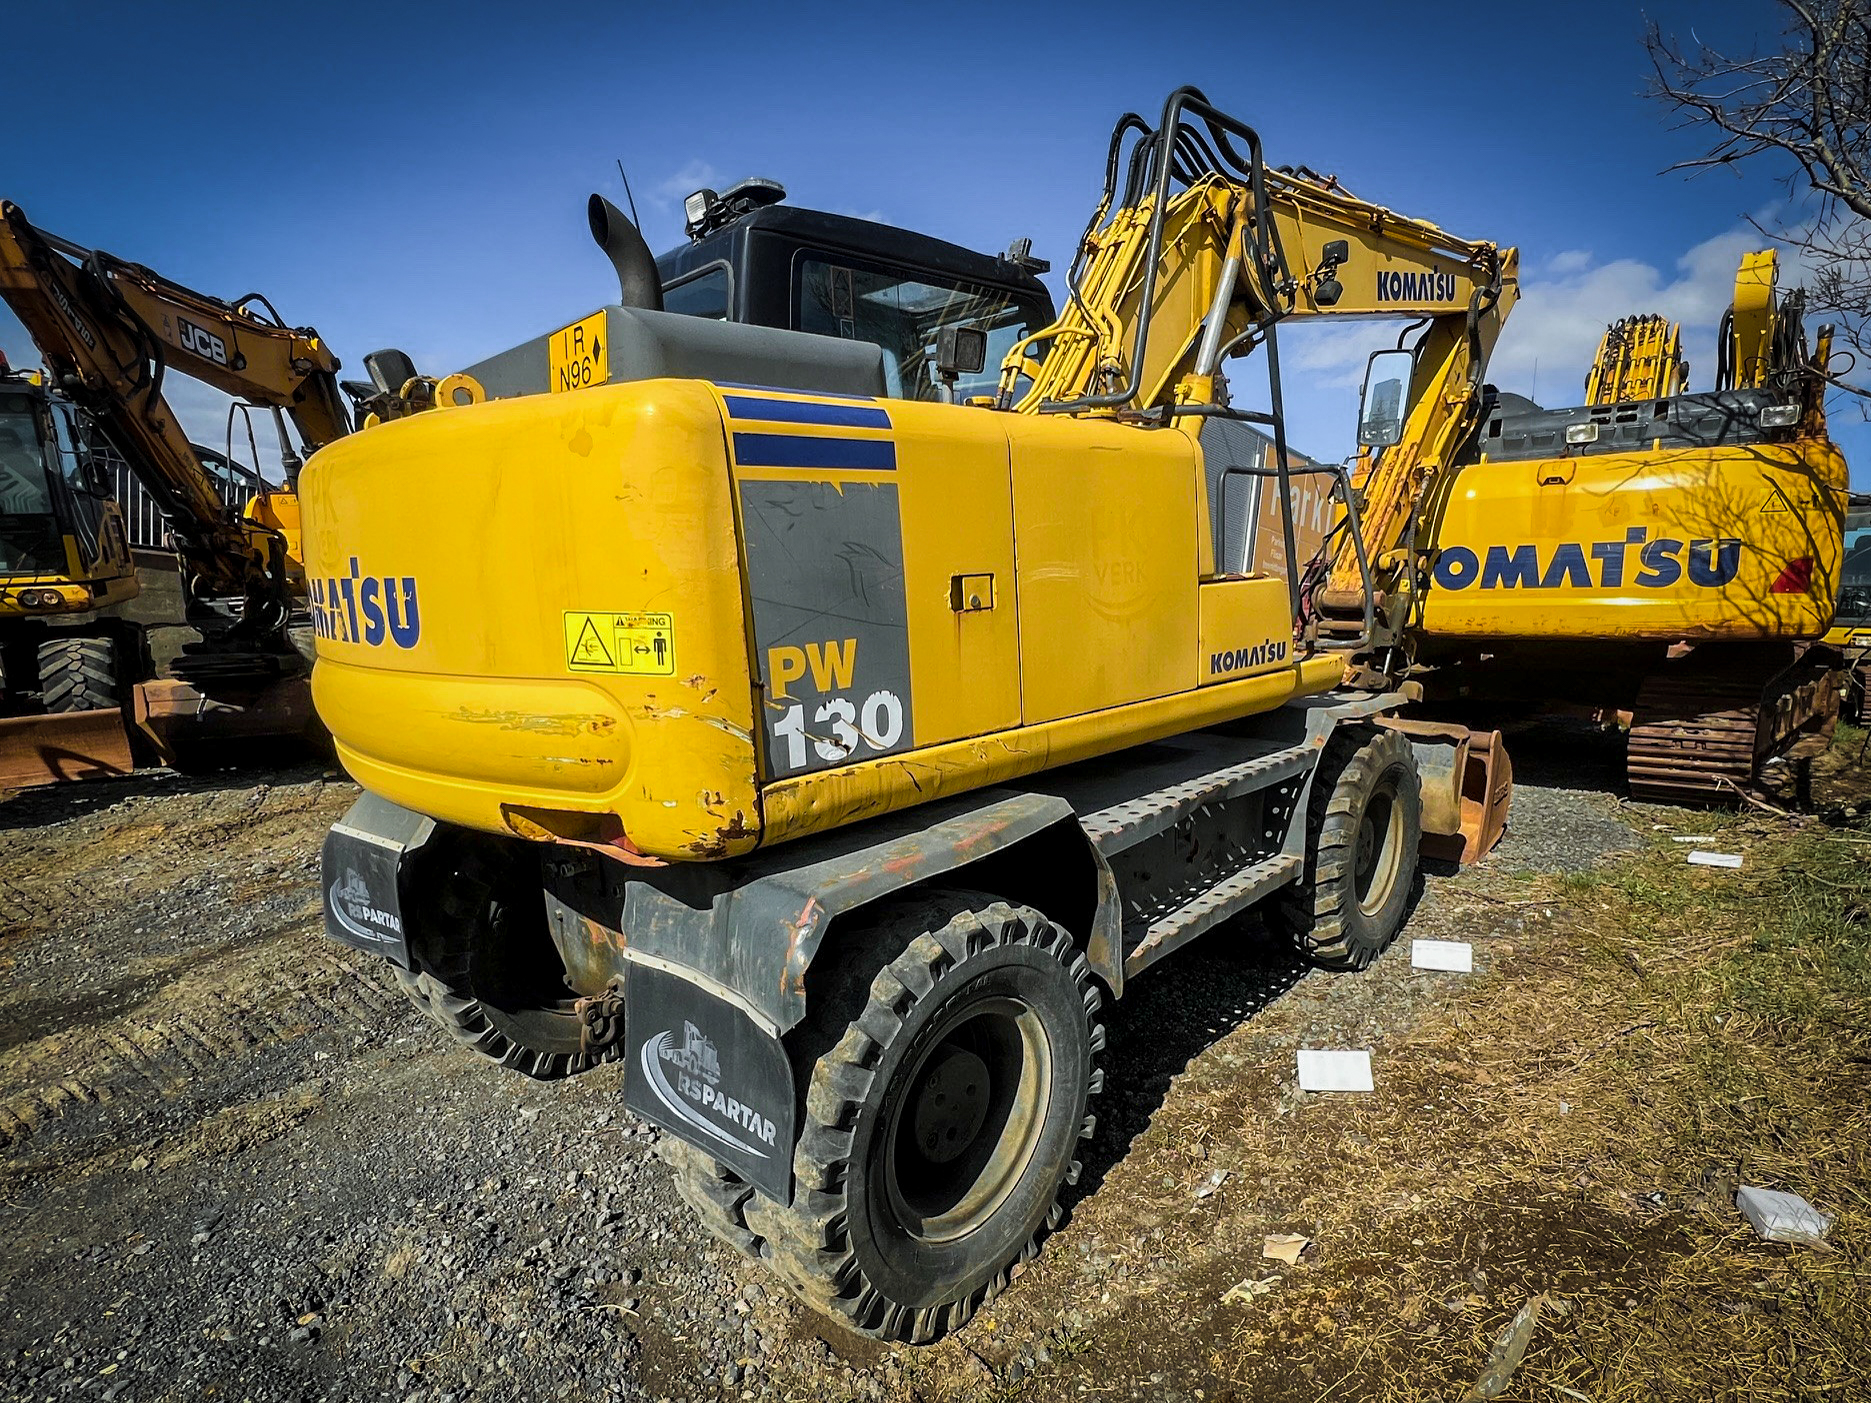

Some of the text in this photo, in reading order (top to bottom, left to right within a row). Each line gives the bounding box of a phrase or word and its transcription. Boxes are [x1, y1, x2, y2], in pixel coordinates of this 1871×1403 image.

[1377, 264, 1456, 302] KOMATSU
[180, 324, 227, 365] JCB
[564, 325, 585, 360] IR
[560, 356, 591, 392] N96
[1432, 526, 1741, 591] OMATSU
[767, 638, 858, 700] PW
[1210, 638, 1286, 675] KOMATSU
[773, 689, 903, 769] 130
[677, 1070, 777, 1147] RSPARTAR
